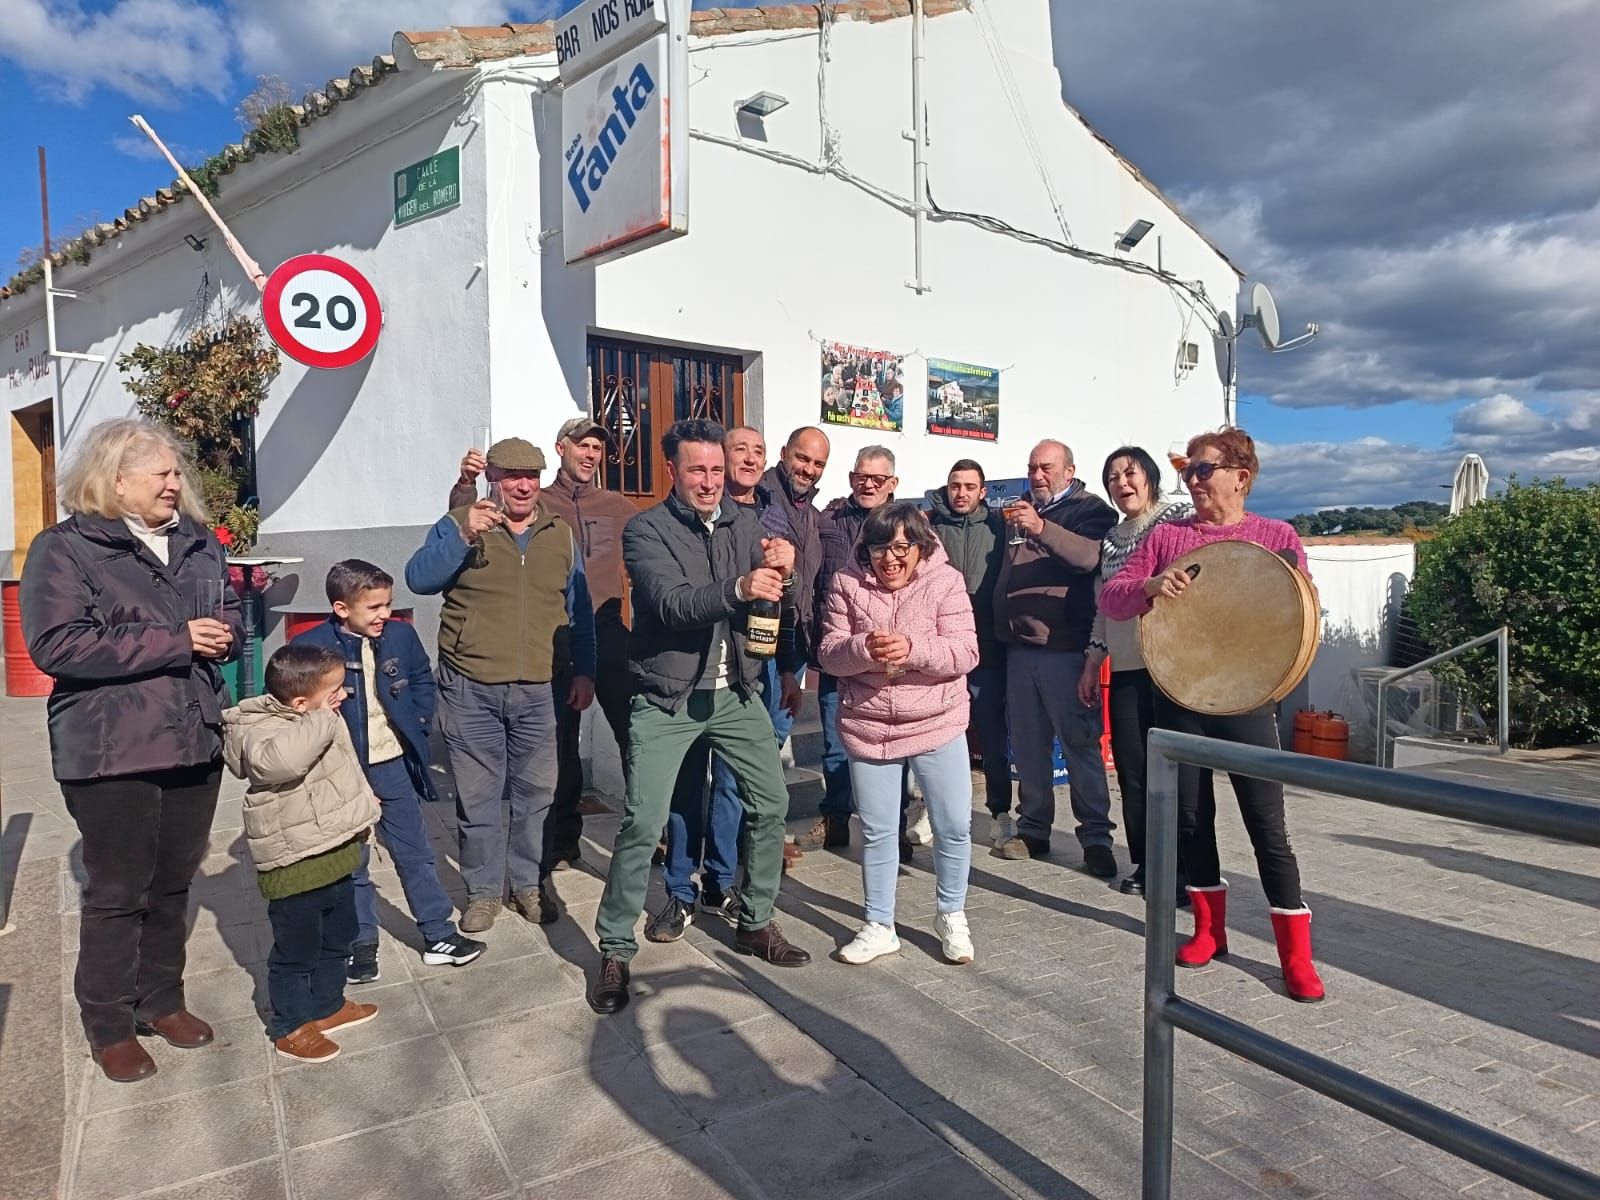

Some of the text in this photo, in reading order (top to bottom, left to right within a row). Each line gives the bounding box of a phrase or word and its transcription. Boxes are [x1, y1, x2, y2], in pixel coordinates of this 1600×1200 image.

[555, 25, 581, 65] BAR
[624, 0, 654, 22] RU
[568, 62, 655, 214] Fanta
[417, 160, 438, 180] CALLE
[418, 178, 437, 191] DE LA
[433, 184, 457, 207] ROMERO
[291, 292, 357, 331] 20
[15, 329, 30, 353] BAR
[29, 350, 49, 380] RUIZ
